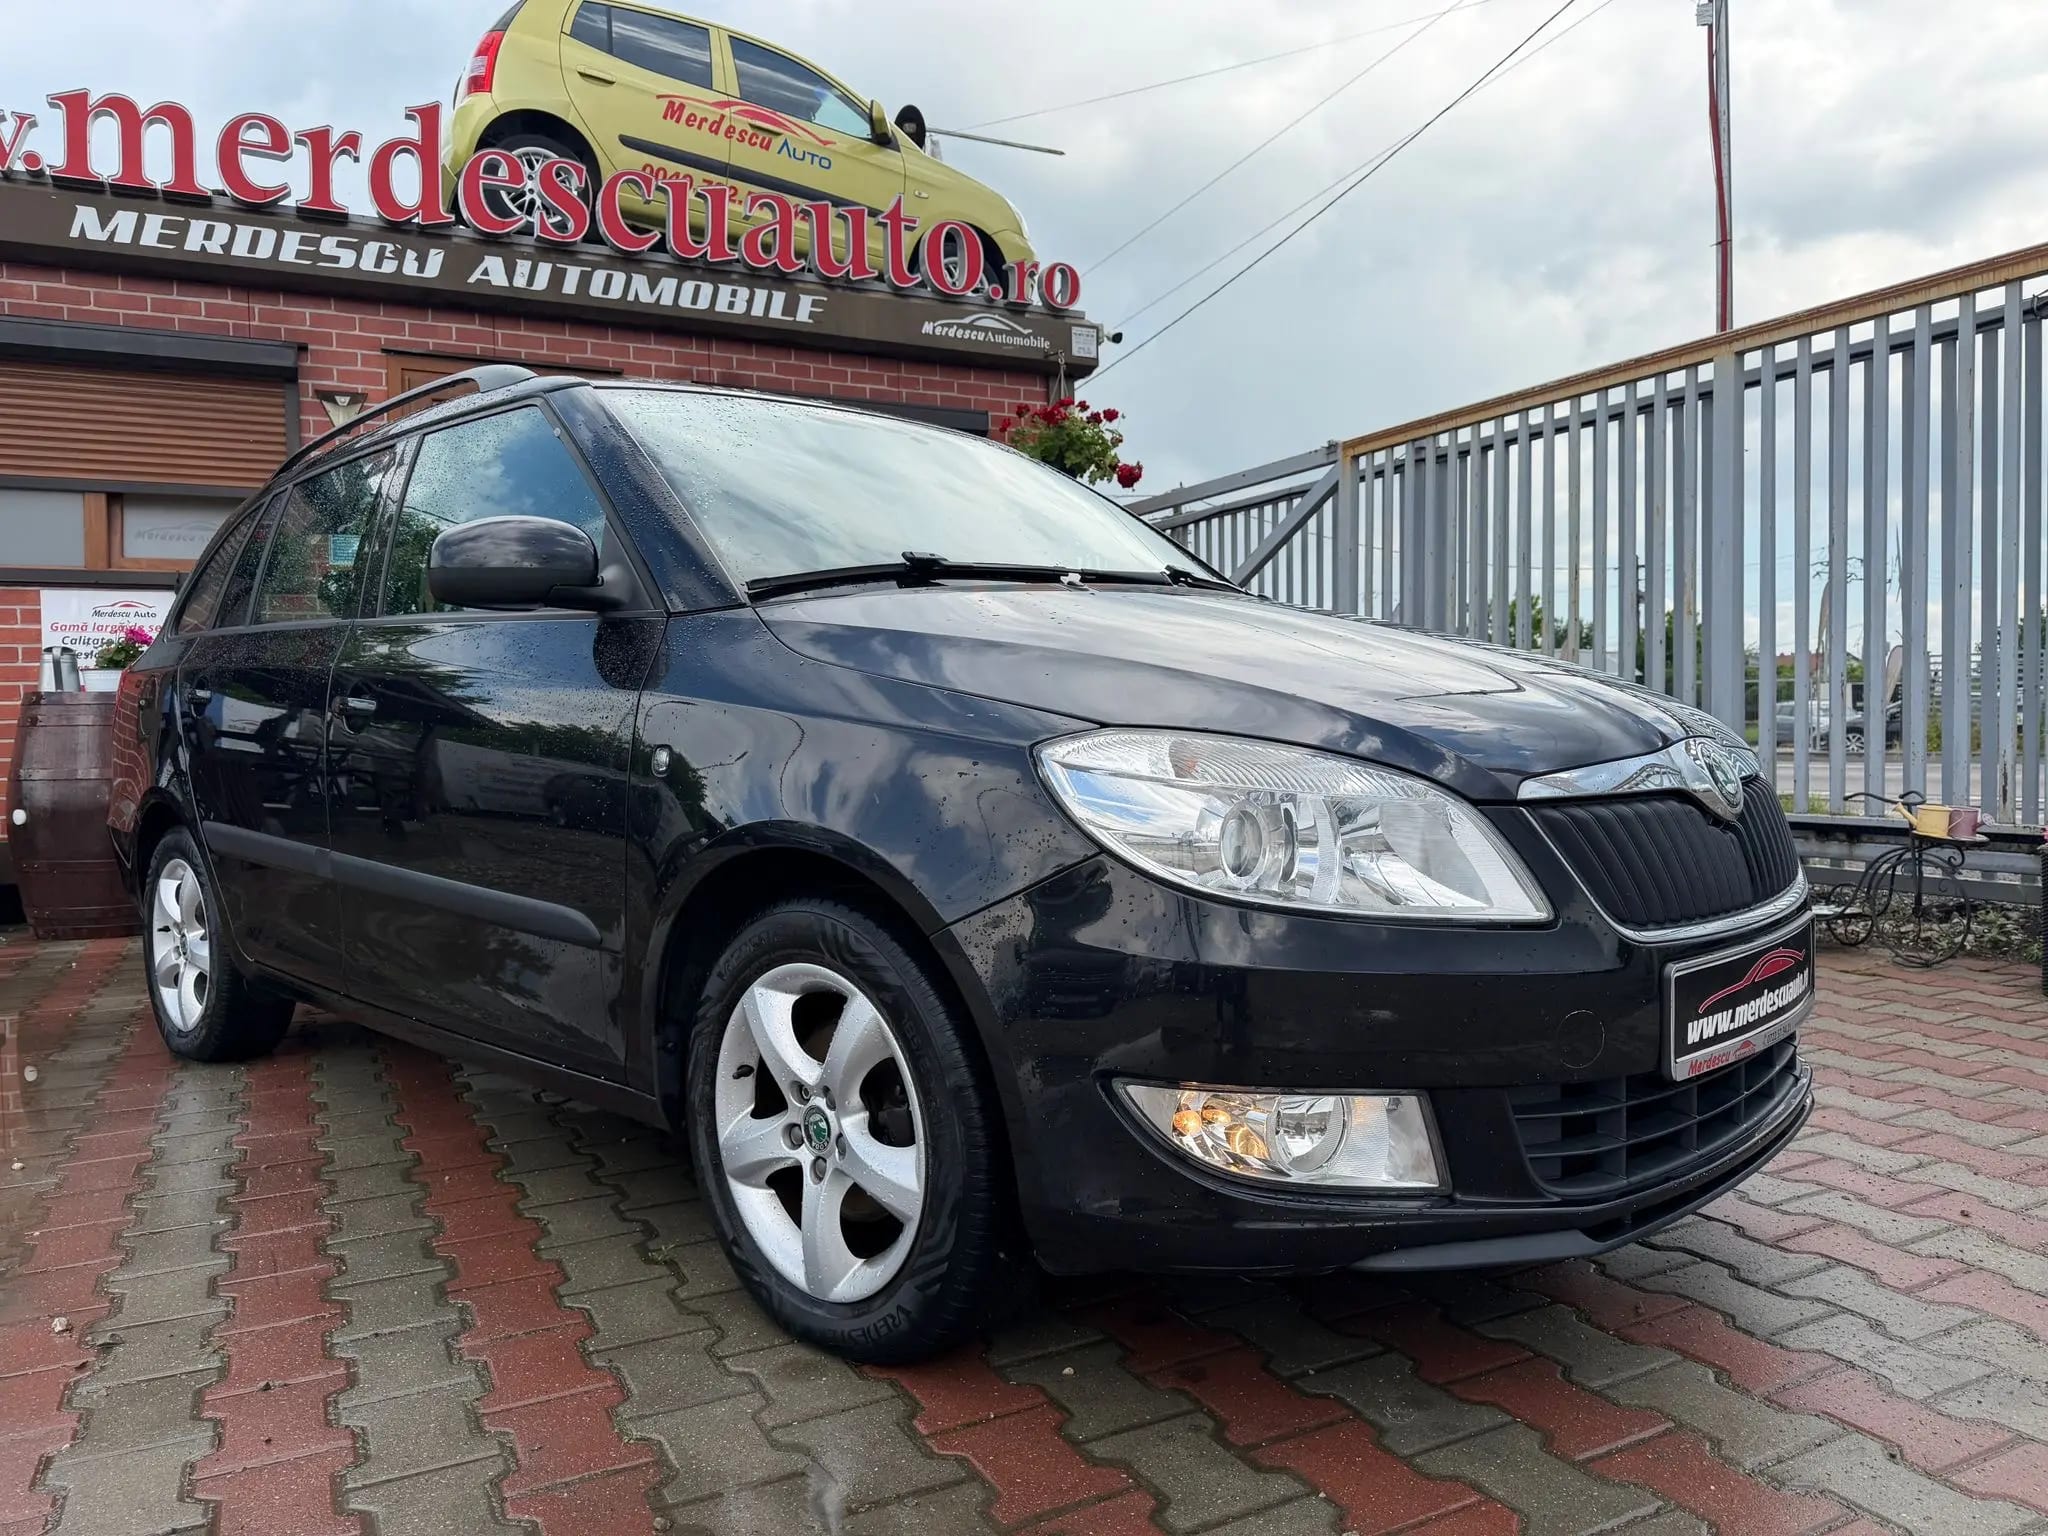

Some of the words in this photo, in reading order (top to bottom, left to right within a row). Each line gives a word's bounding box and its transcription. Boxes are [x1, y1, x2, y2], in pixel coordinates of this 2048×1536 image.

[662, 99, 773, 152] Merdescu
[69, 204, 445, 279] MERDESCU
[466, 254, 828, 323] AUTOMOBILE
[50, 621, 88, 632] Gamă
[91, 609, 131, 618] Merdescu
[133, 610, 157, 618] Auto
[1687, 1049, 1732, 1077] Merdescu
